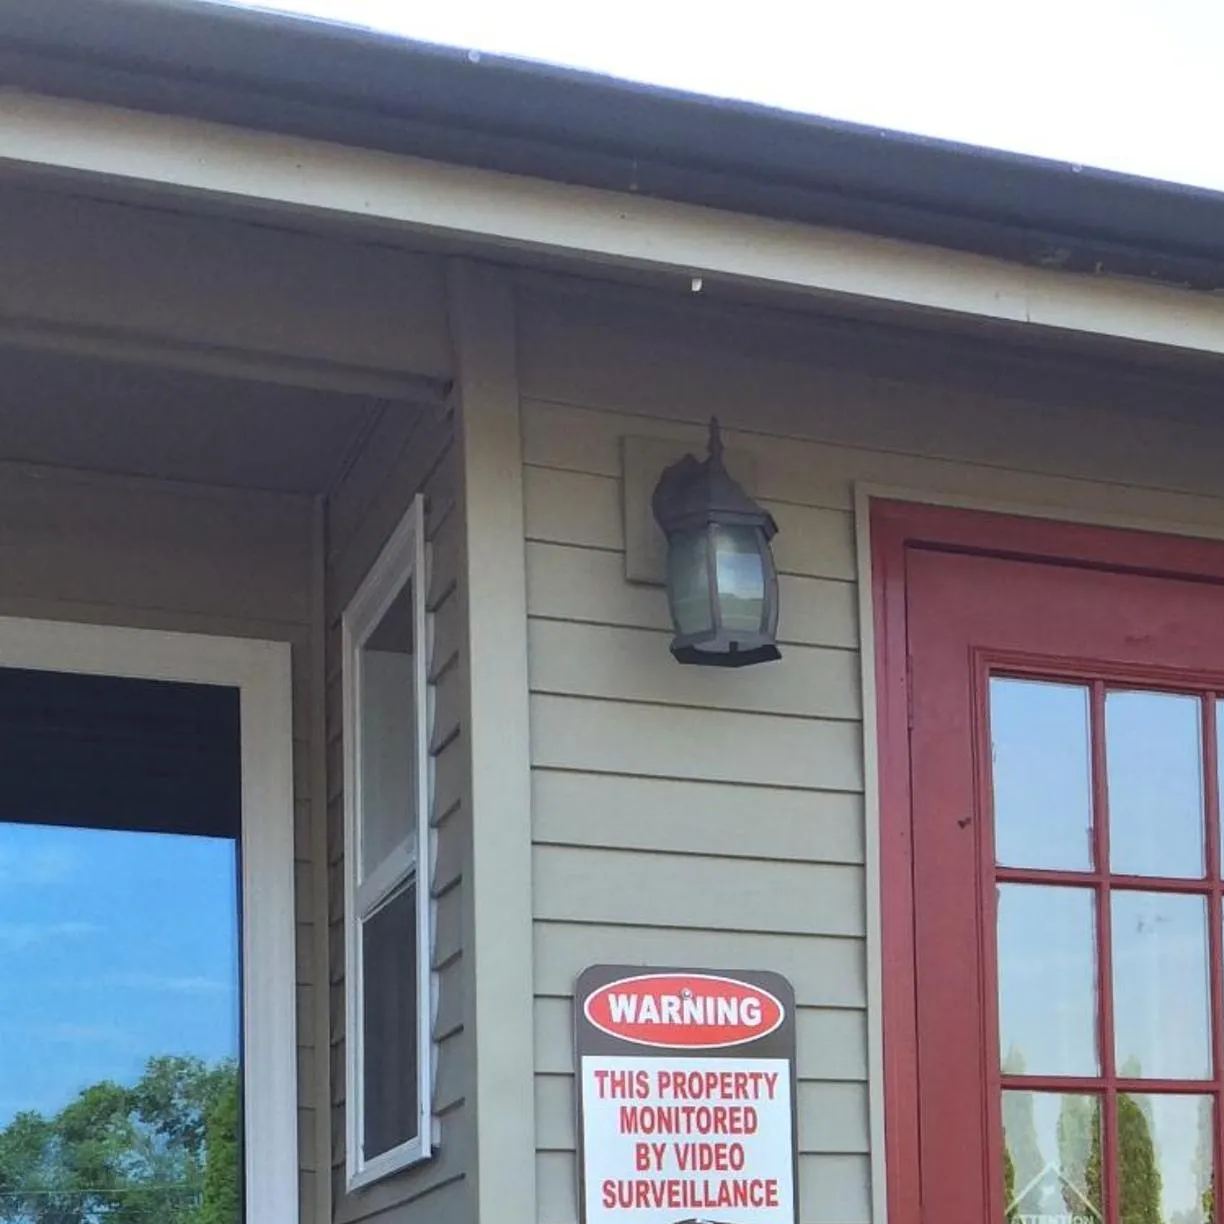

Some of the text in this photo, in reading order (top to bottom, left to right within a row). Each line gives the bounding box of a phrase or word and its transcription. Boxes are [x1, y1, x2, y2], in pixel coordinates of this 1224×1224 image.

[607, 992, 763, 1027] WARNING
[594, 1069, 779, 1100] THIS PROPERTY
[619, 1105, 758, 1136] MONITORED
[635, 1142, 746, 1171] BY VIDEO
[602, 1179, 779, 1209] SURVEILLANCE
